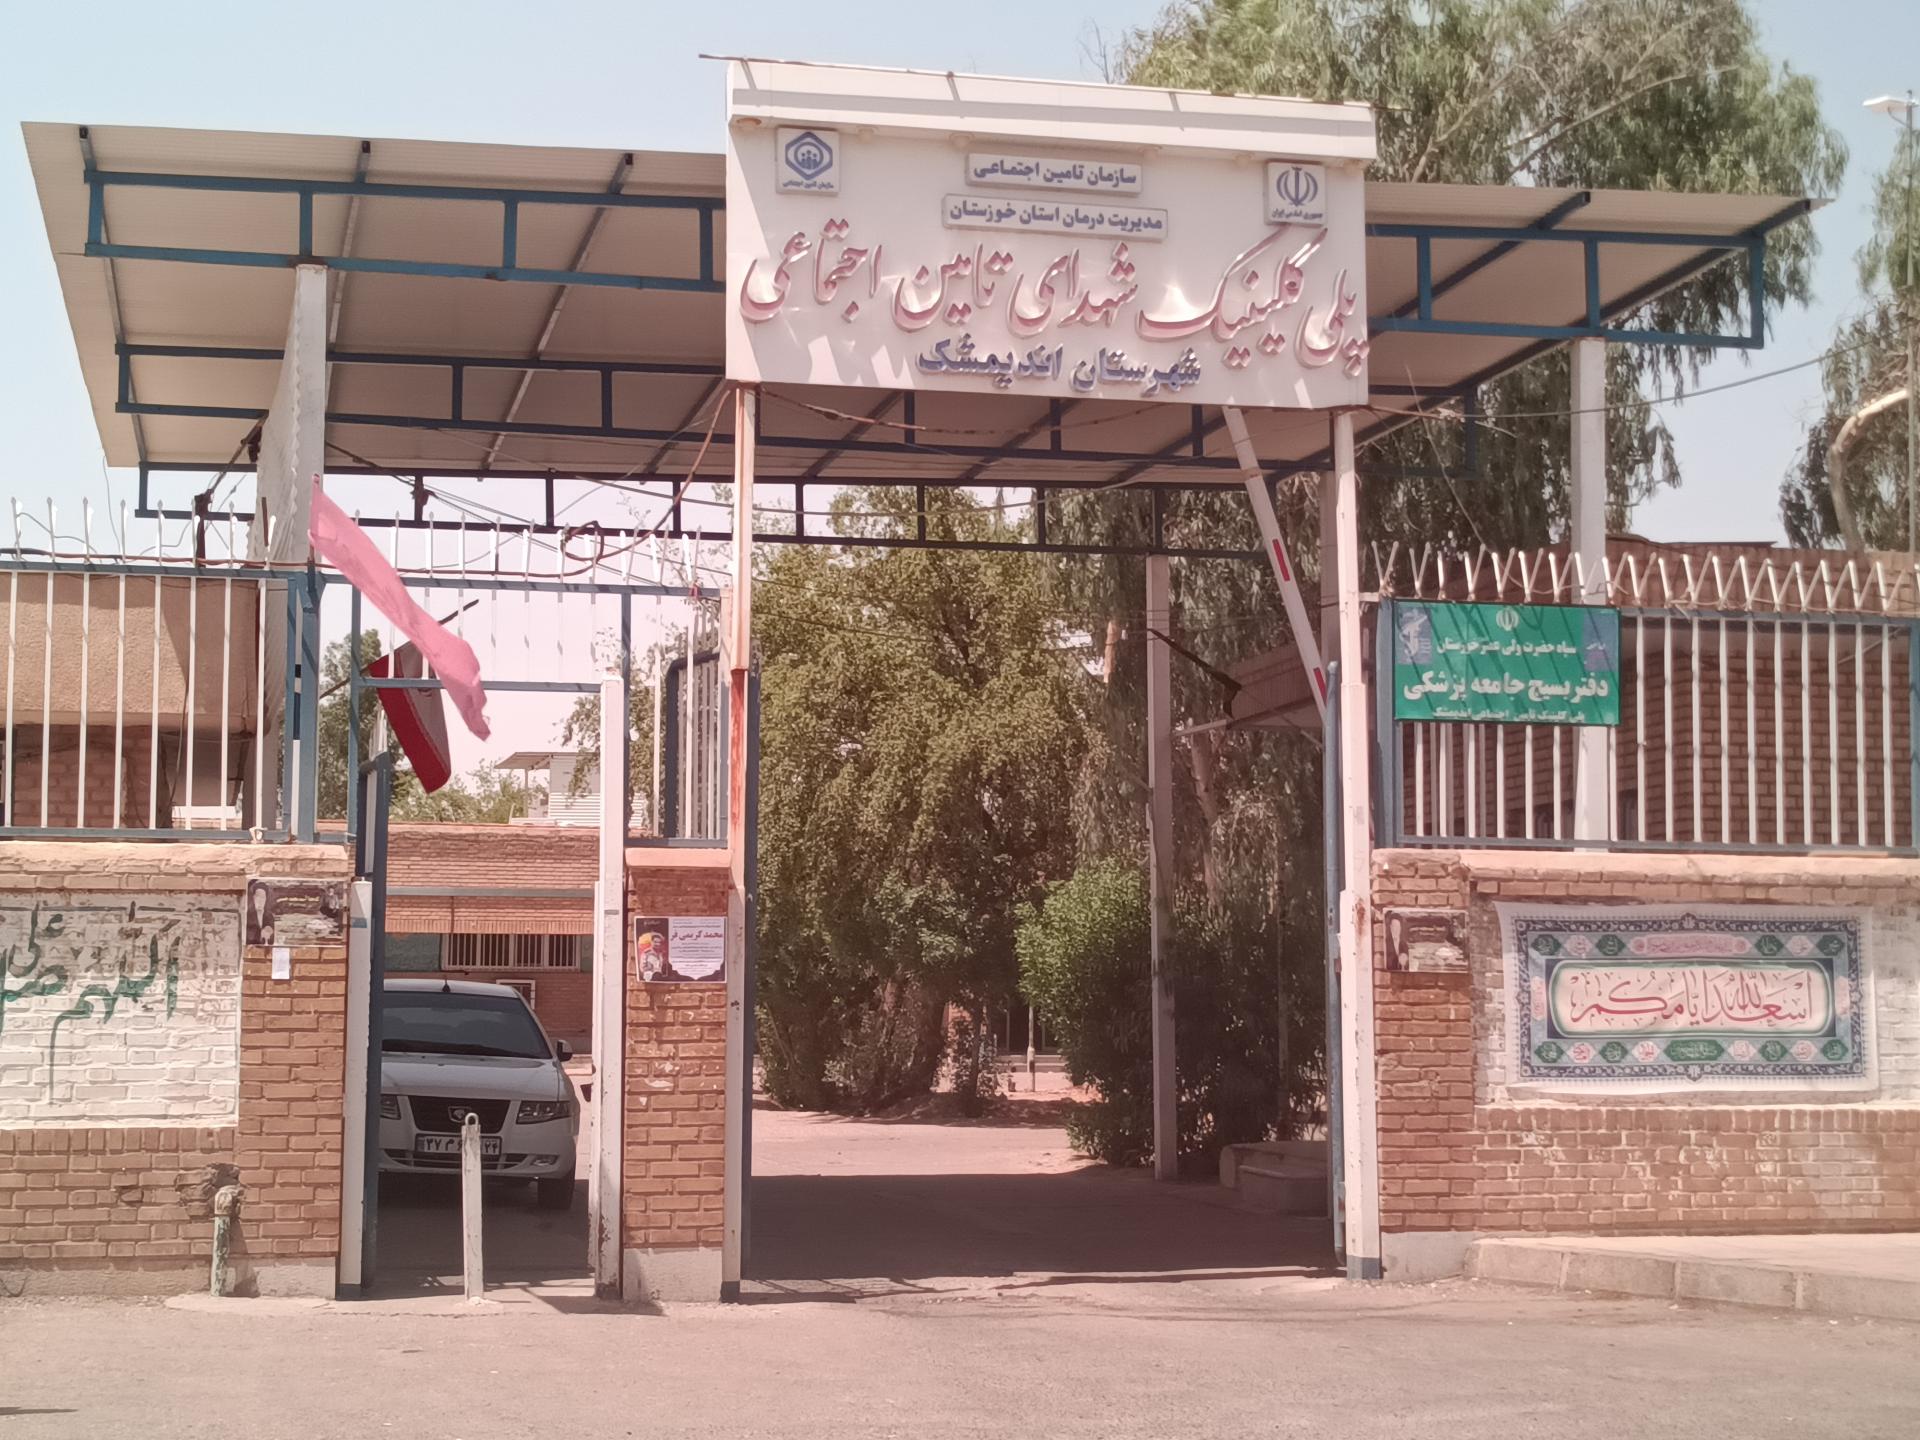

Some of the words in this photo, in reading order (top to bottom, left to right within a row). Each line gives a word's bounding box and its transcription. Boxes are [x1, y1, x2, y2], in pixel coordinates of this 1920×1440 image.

[973, 159, 1040, 181] اجتماعی
[1042, 164, 1085, 183] تامین
[1086, 165, 1137, 188] سازمان
[949, 200, 1017, 223] خوزستان
[1019, 204, 1060, 225] استان
[1062, 208, 1105, 230] درمان
[1107, 214, 1163, 233] مدیریت
[739, 217, 883, 324] اجتماعی
[891, 241, 1014, 333] تامین
[1005, 240, 1139, 339] شهدای
[1134, 225, 1329, 369] کلینیک
[1294, 268, 1370, 379] پلی
[915, 332, 1064, 389] اندیمشک
[1069, 346, 1202, 397] شهرستان
[1502, 638, 1522, 656] ولی
[1522, 639, 1555, 657] حضرت
[1556, 640, 1577, 658] سپاه
[1403, 671, 1467, 700] پزشکی
[1470, 672, 1526, 700] جامعه
[1528, 679, 1571, 702] بسیج
[1570, 672, 1609, 703] دفتر
